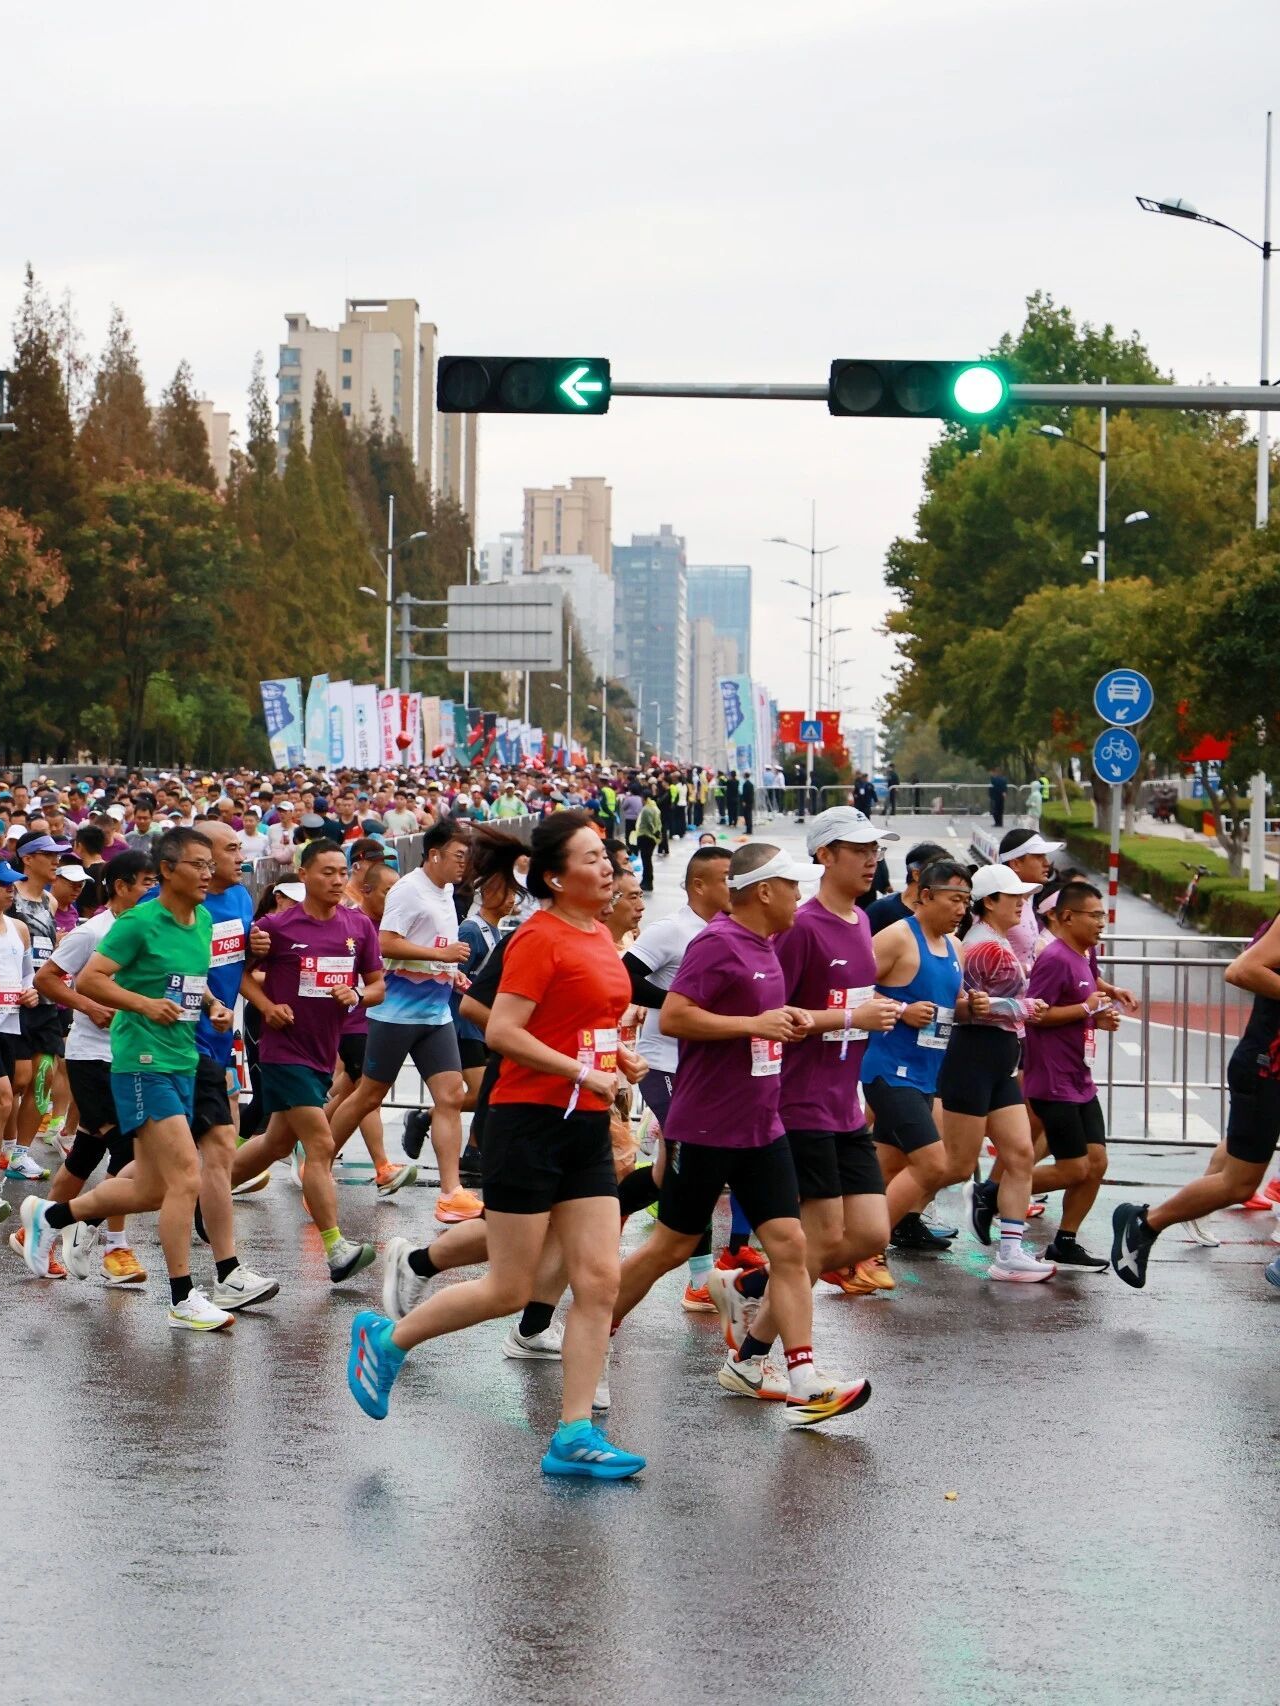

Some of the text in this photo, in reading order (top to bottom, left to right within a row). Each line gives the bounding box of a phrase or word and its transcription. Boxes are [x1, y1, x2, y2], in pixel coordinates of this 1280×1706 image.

[218, 938, 240, 951] 7688
[438, 937, 447, 947] B
[305, 957, 314, 968] B
[171, 975, 180, 987] B
[324, 974, 348, 984] 6001
[833, 990, 843, 1004] B
[583, 1030, 593, 1046] B
